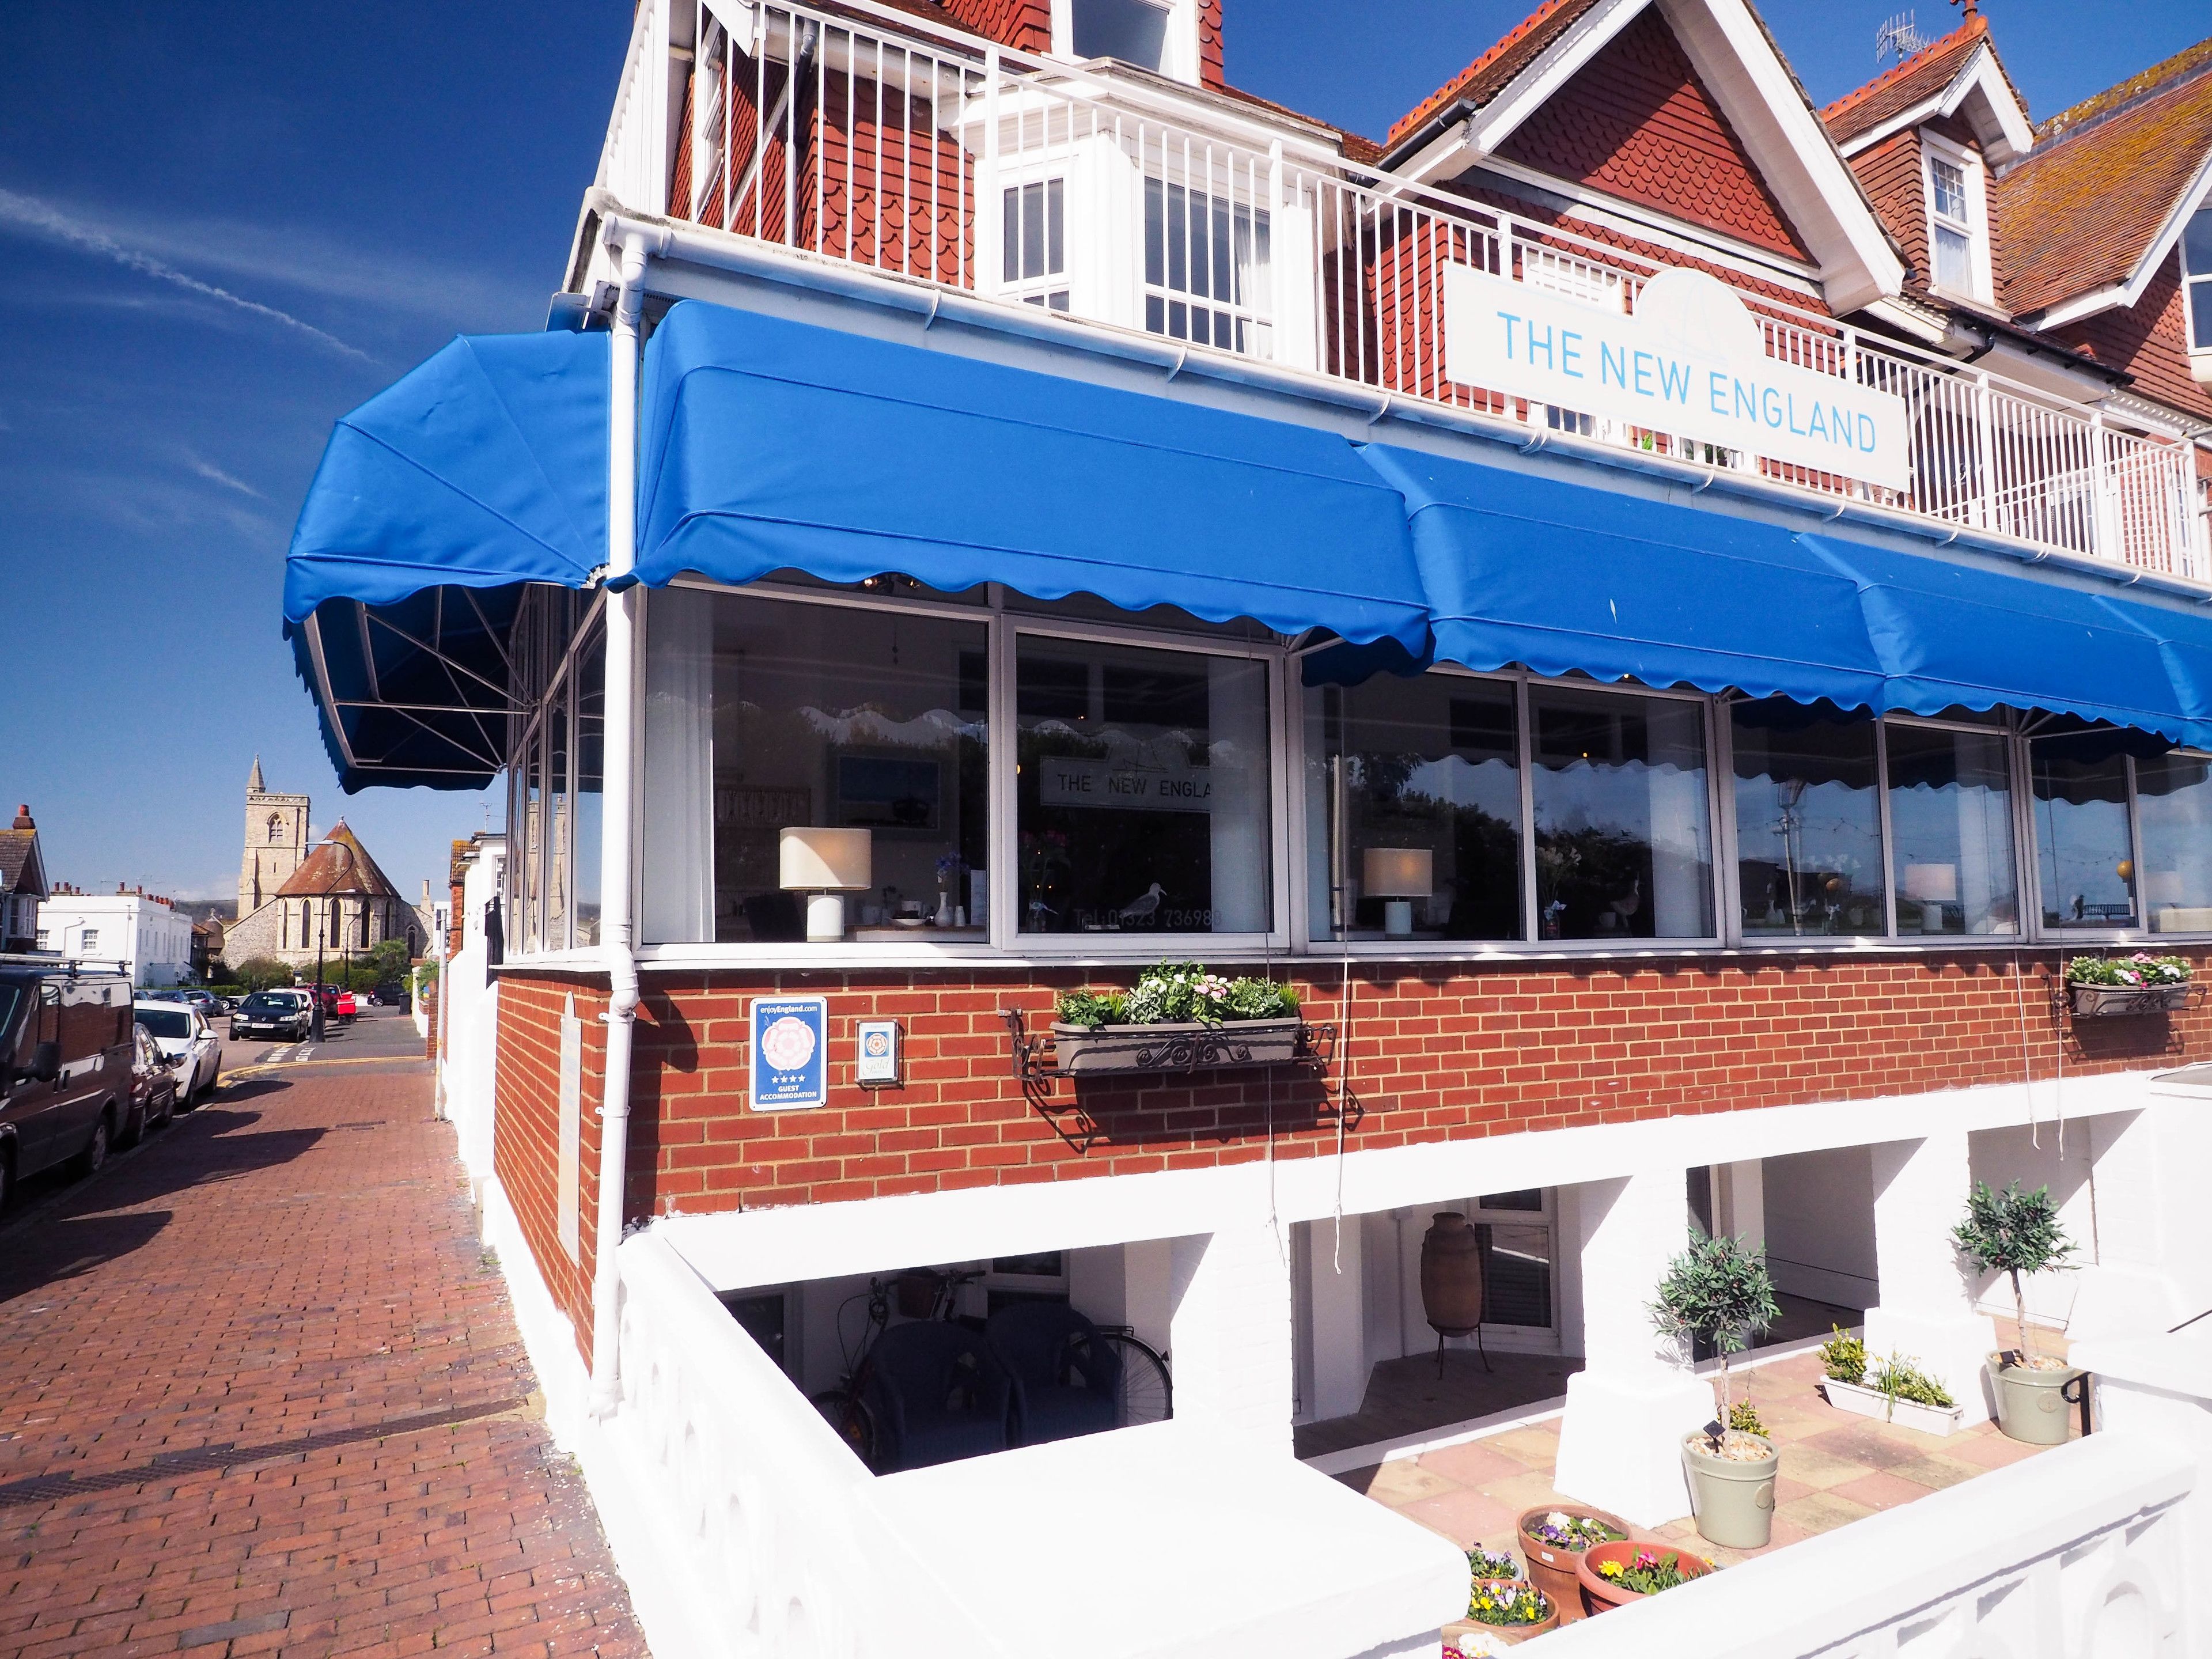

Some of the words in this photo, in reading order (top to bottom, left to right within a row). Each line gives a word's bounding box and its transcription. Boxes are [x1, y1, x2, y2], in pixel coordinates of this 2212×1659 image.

[1497, 310, 1584, 378] THE
[1601, 341, 1691, 405] NEW
[1710, 370, 1876, 453] ENGLAND
[1058, 775, 1091, 792] THE
[1108, 778, 1146, 795] NEW
[1160, 780, 1211, 798] ENGLA
[760, 1005, 817, 1014] enjoyEngland.com
[760, 1091, 817, 1100] ACCOMMODATION
